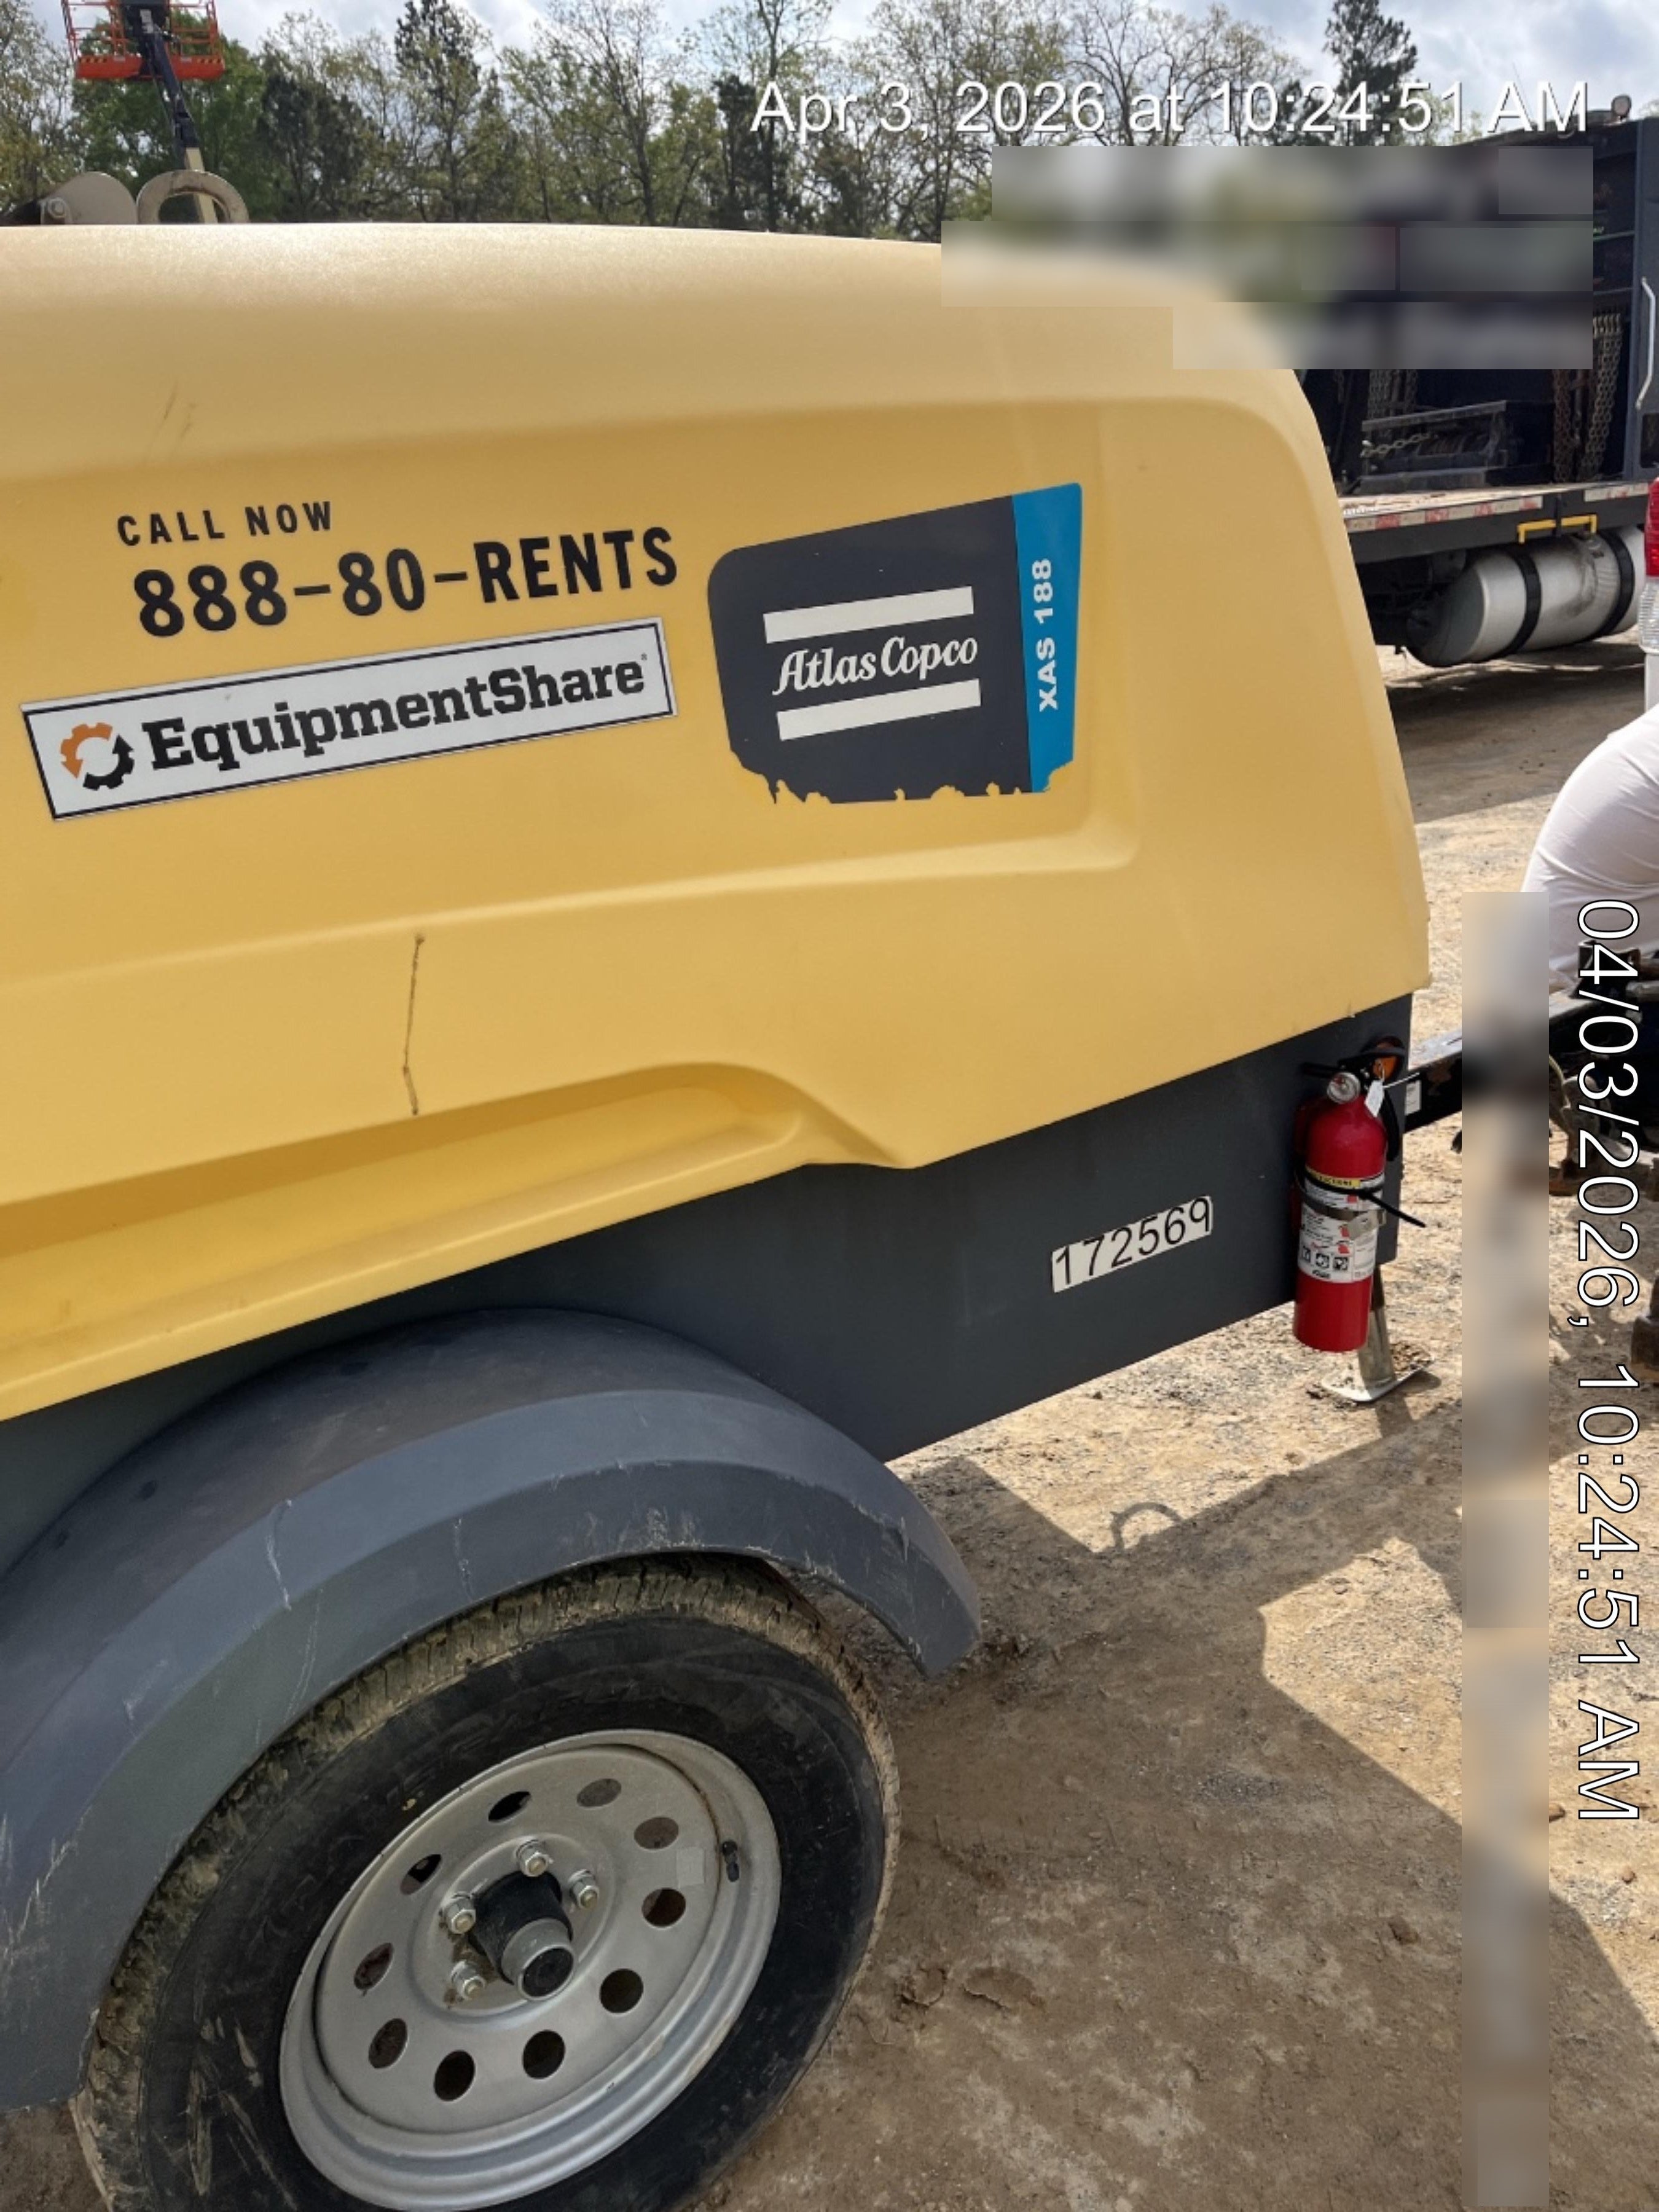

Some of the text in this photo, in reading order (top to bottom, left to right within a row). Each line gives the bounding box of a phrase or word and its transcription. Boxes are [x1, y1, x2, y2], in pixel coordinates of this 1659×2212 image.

[117, 501, 331, 546] CALL NOW
[133, 527, 678, 638] 888-80-RENTS
[772, 636, 978, 696] Atlas Copco
[1032, 559, 1057, 712] XAS 188
[142, 660, 645, 771] EquipmentShare
[1056, 1197, 1210, 1285] 172569
